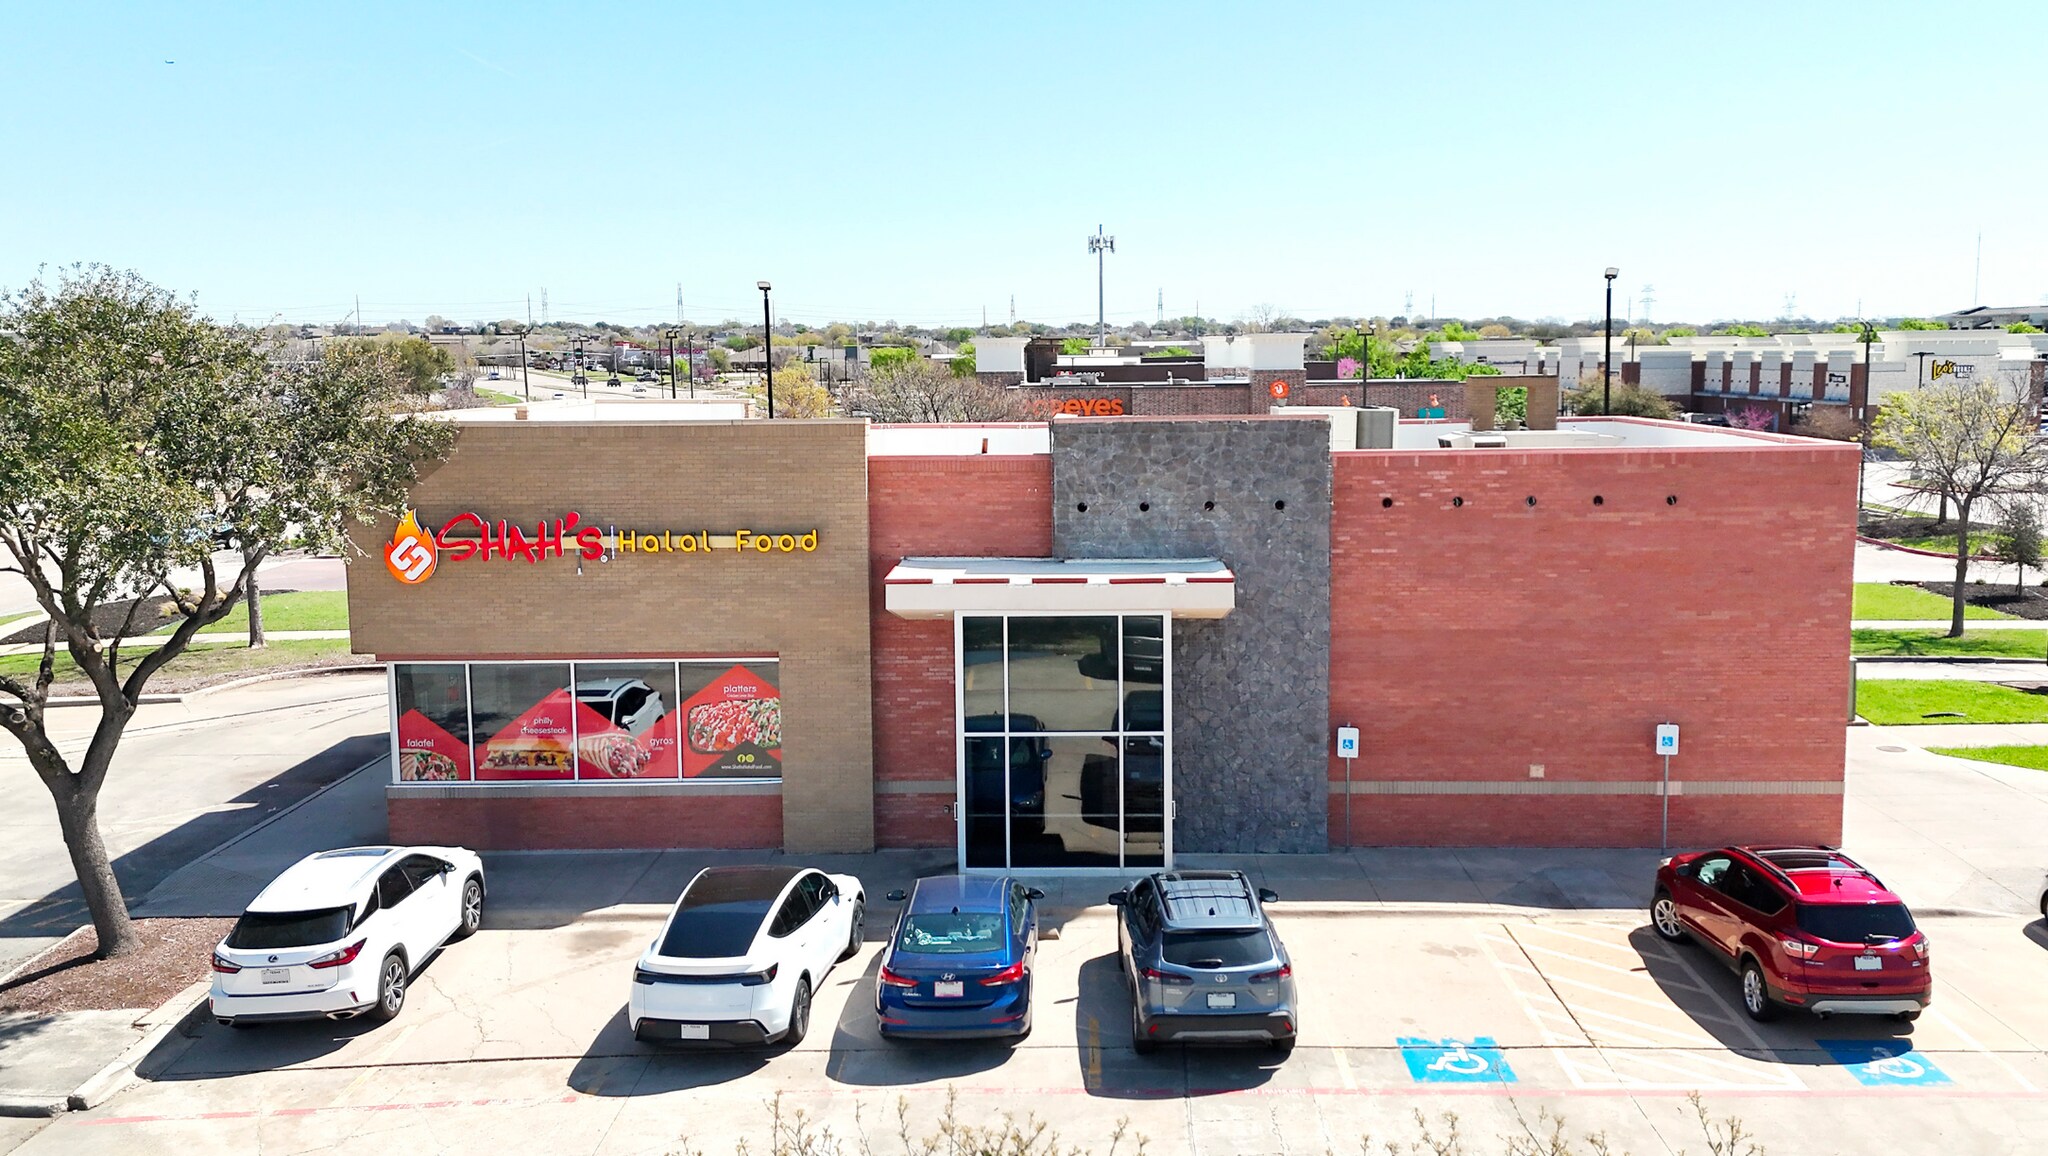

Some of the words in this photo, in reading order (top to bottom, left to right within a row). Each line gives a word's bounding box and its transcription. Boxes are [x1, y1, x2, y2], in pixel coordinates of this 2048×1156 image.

[435, 511, 604, 564] SHAH'S
[619, 529, 713, 553] Halal
[736, 528, 818, 553] Food
[723, 684, 757, 694] platters
[533, 716, 554, 726] philly
[520, 726, 568, 735] cheesesteak
[406, 738, 435, 748] falafel
[649, 737, 674, 747] gyros
